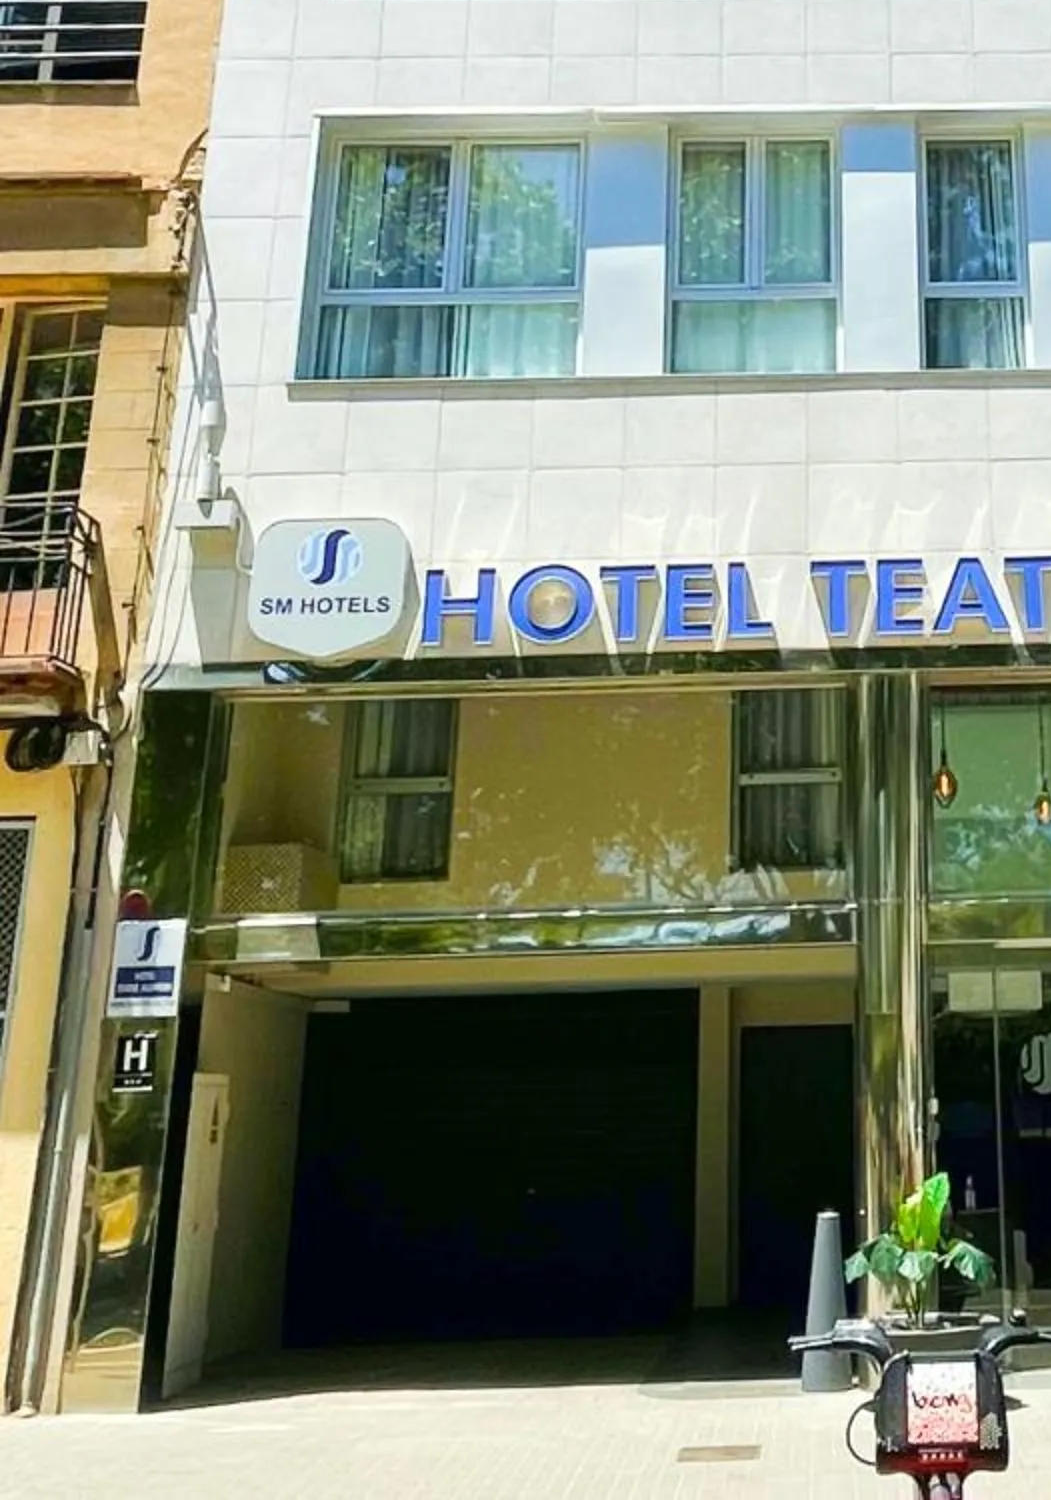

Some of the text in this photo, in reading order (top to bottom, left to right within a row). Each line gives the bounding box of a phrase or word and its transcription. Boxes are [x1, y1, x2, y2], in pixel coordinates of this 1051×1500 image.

[259, 595, 391, 616] SM HOTELS
[422, 560, 774, 646] HOTEL
[123, 1039, 149, 1072] H
